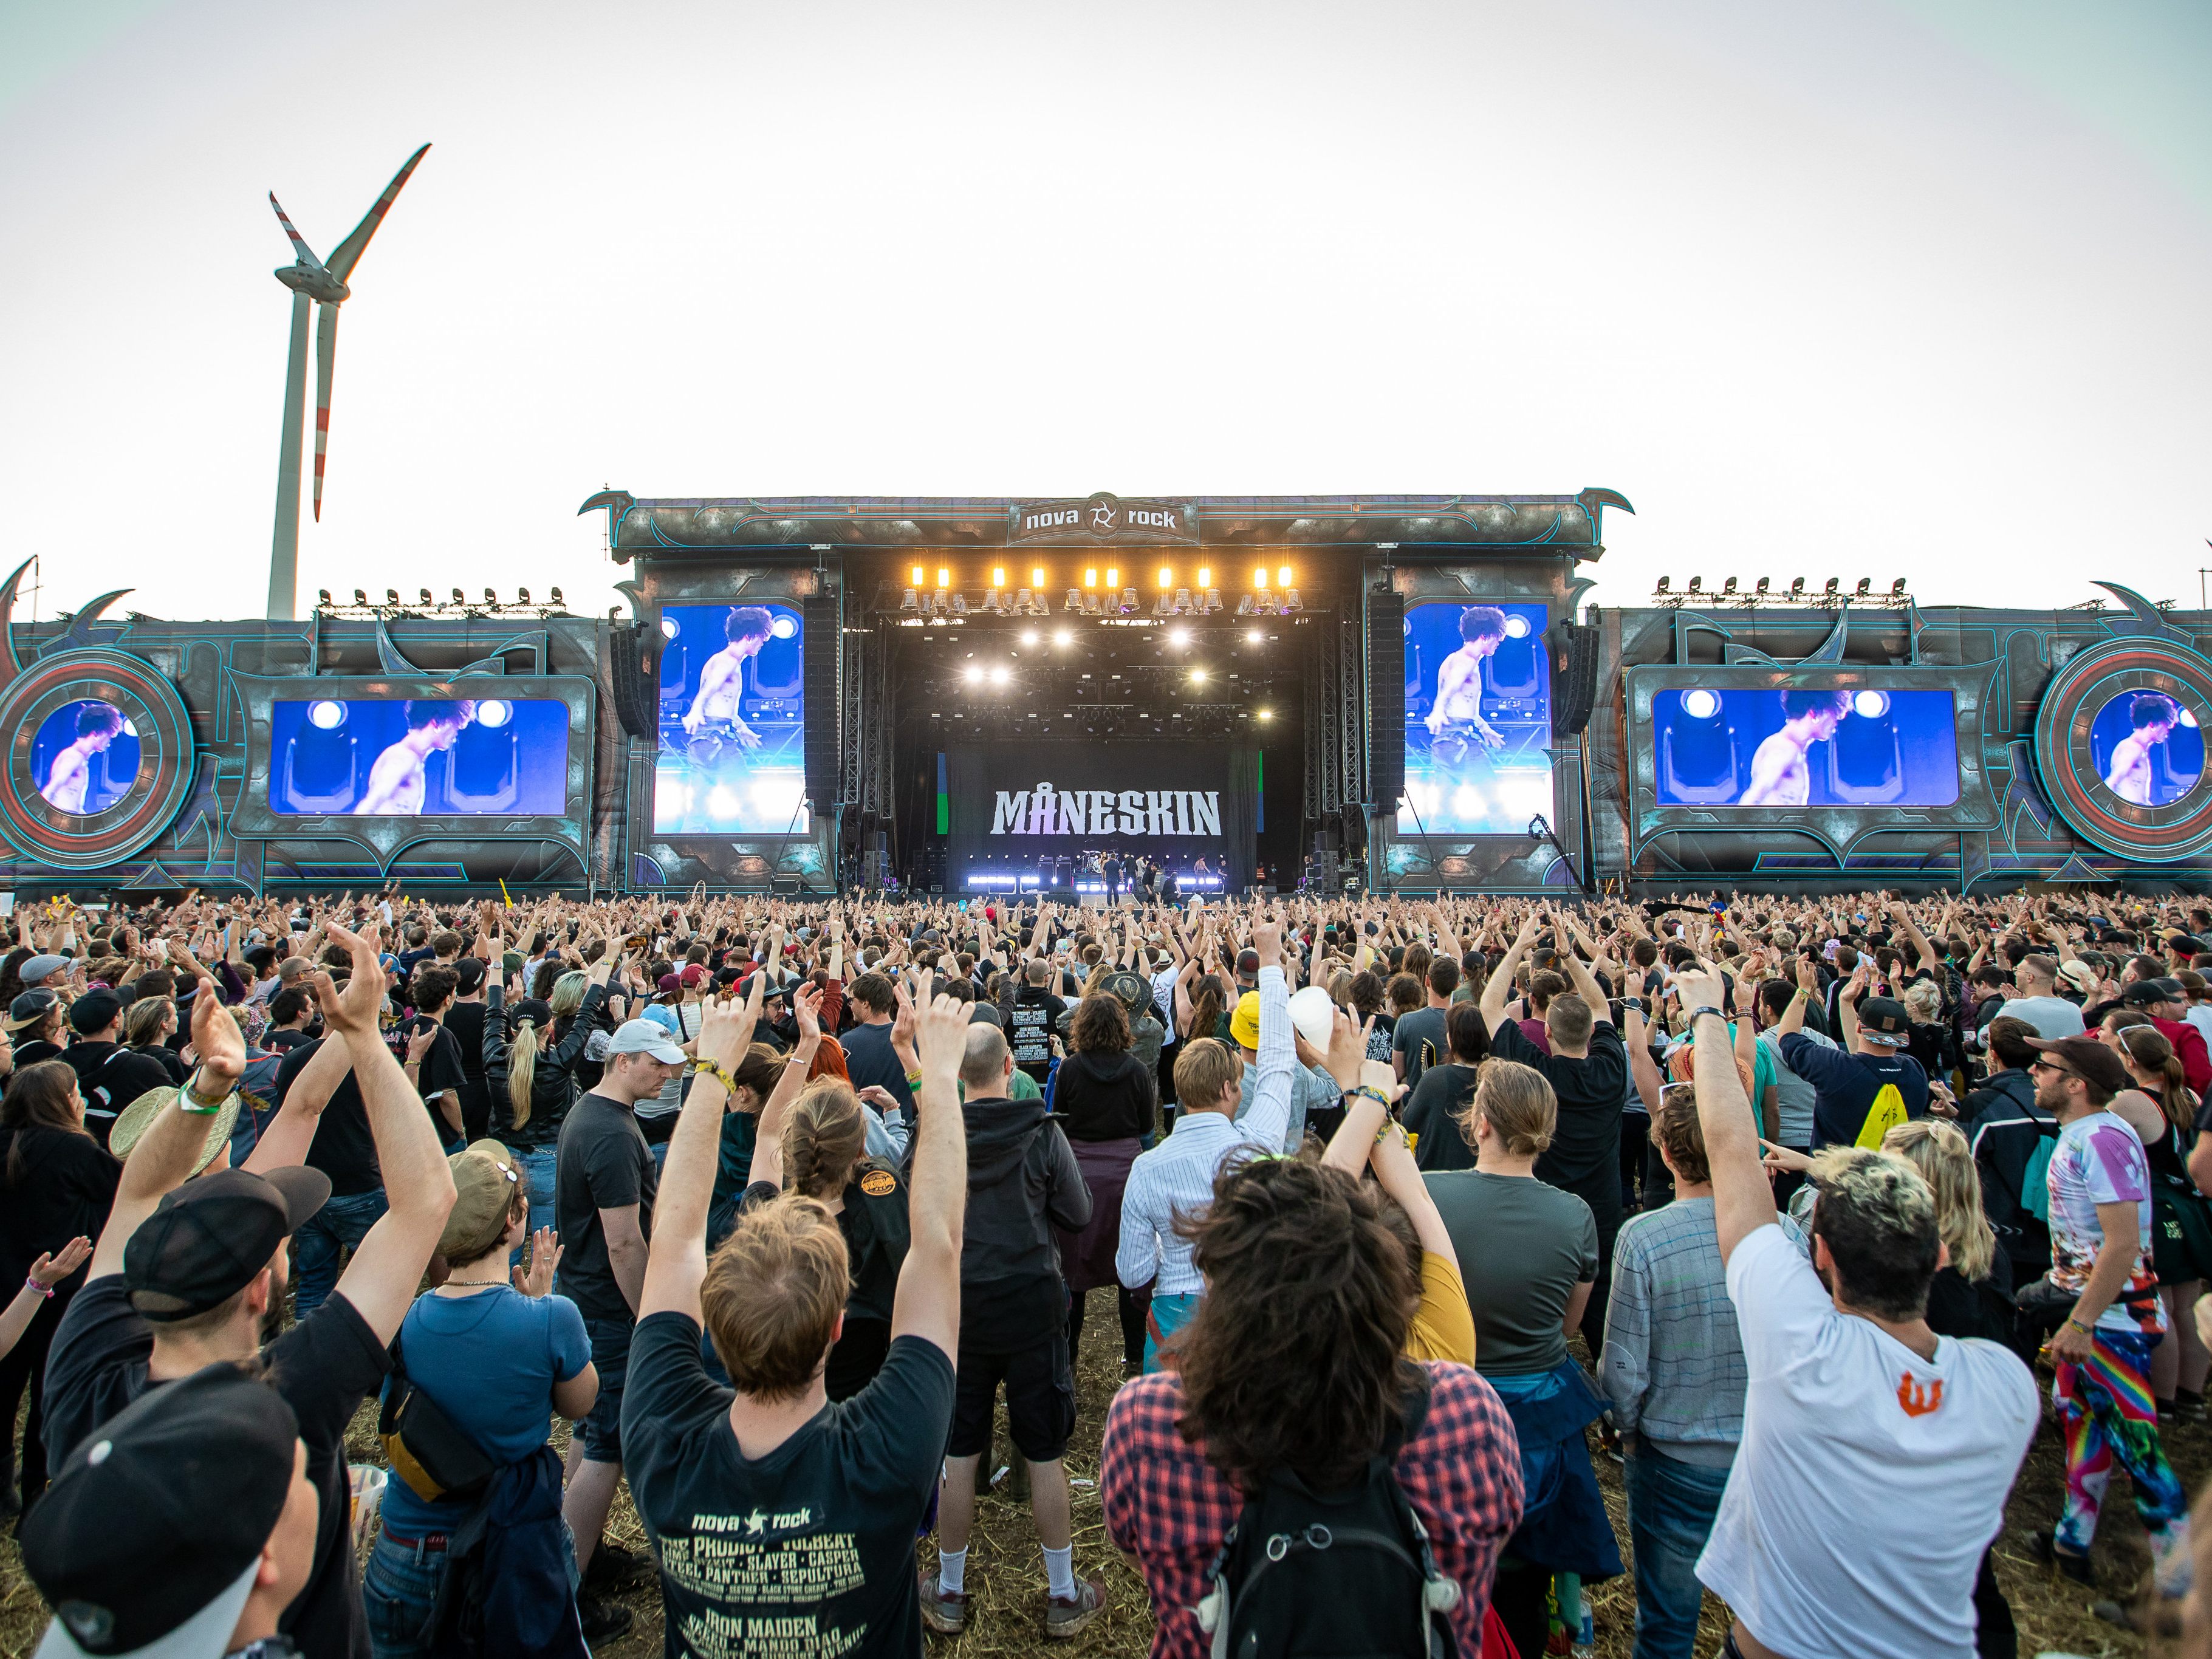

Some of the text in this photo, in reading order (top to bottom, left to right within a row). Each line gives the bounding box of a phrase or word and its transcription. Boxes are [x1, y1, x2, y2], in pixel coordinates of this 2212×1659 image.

[1026, 510, 1177, 530] nova rock
[990, 782, 1222, 836] MÅNESKIN
[691, 1507, 811, 1532] nova rock
[747, 1551, 797, 1571] SLAYER
[809, 1548, 859, 1567] CASPER
[706, 1566, 769, 1584] PANTHER
[781, 1562, 863, 1584] SEPULTURA
[706, 1607, 742, 1639] IRON
[747, 1615, 817, 1638] MAIDEN
[744, 1637, 800, 1652] MANDO
[804, 1626, 840, 1652] DIAO
